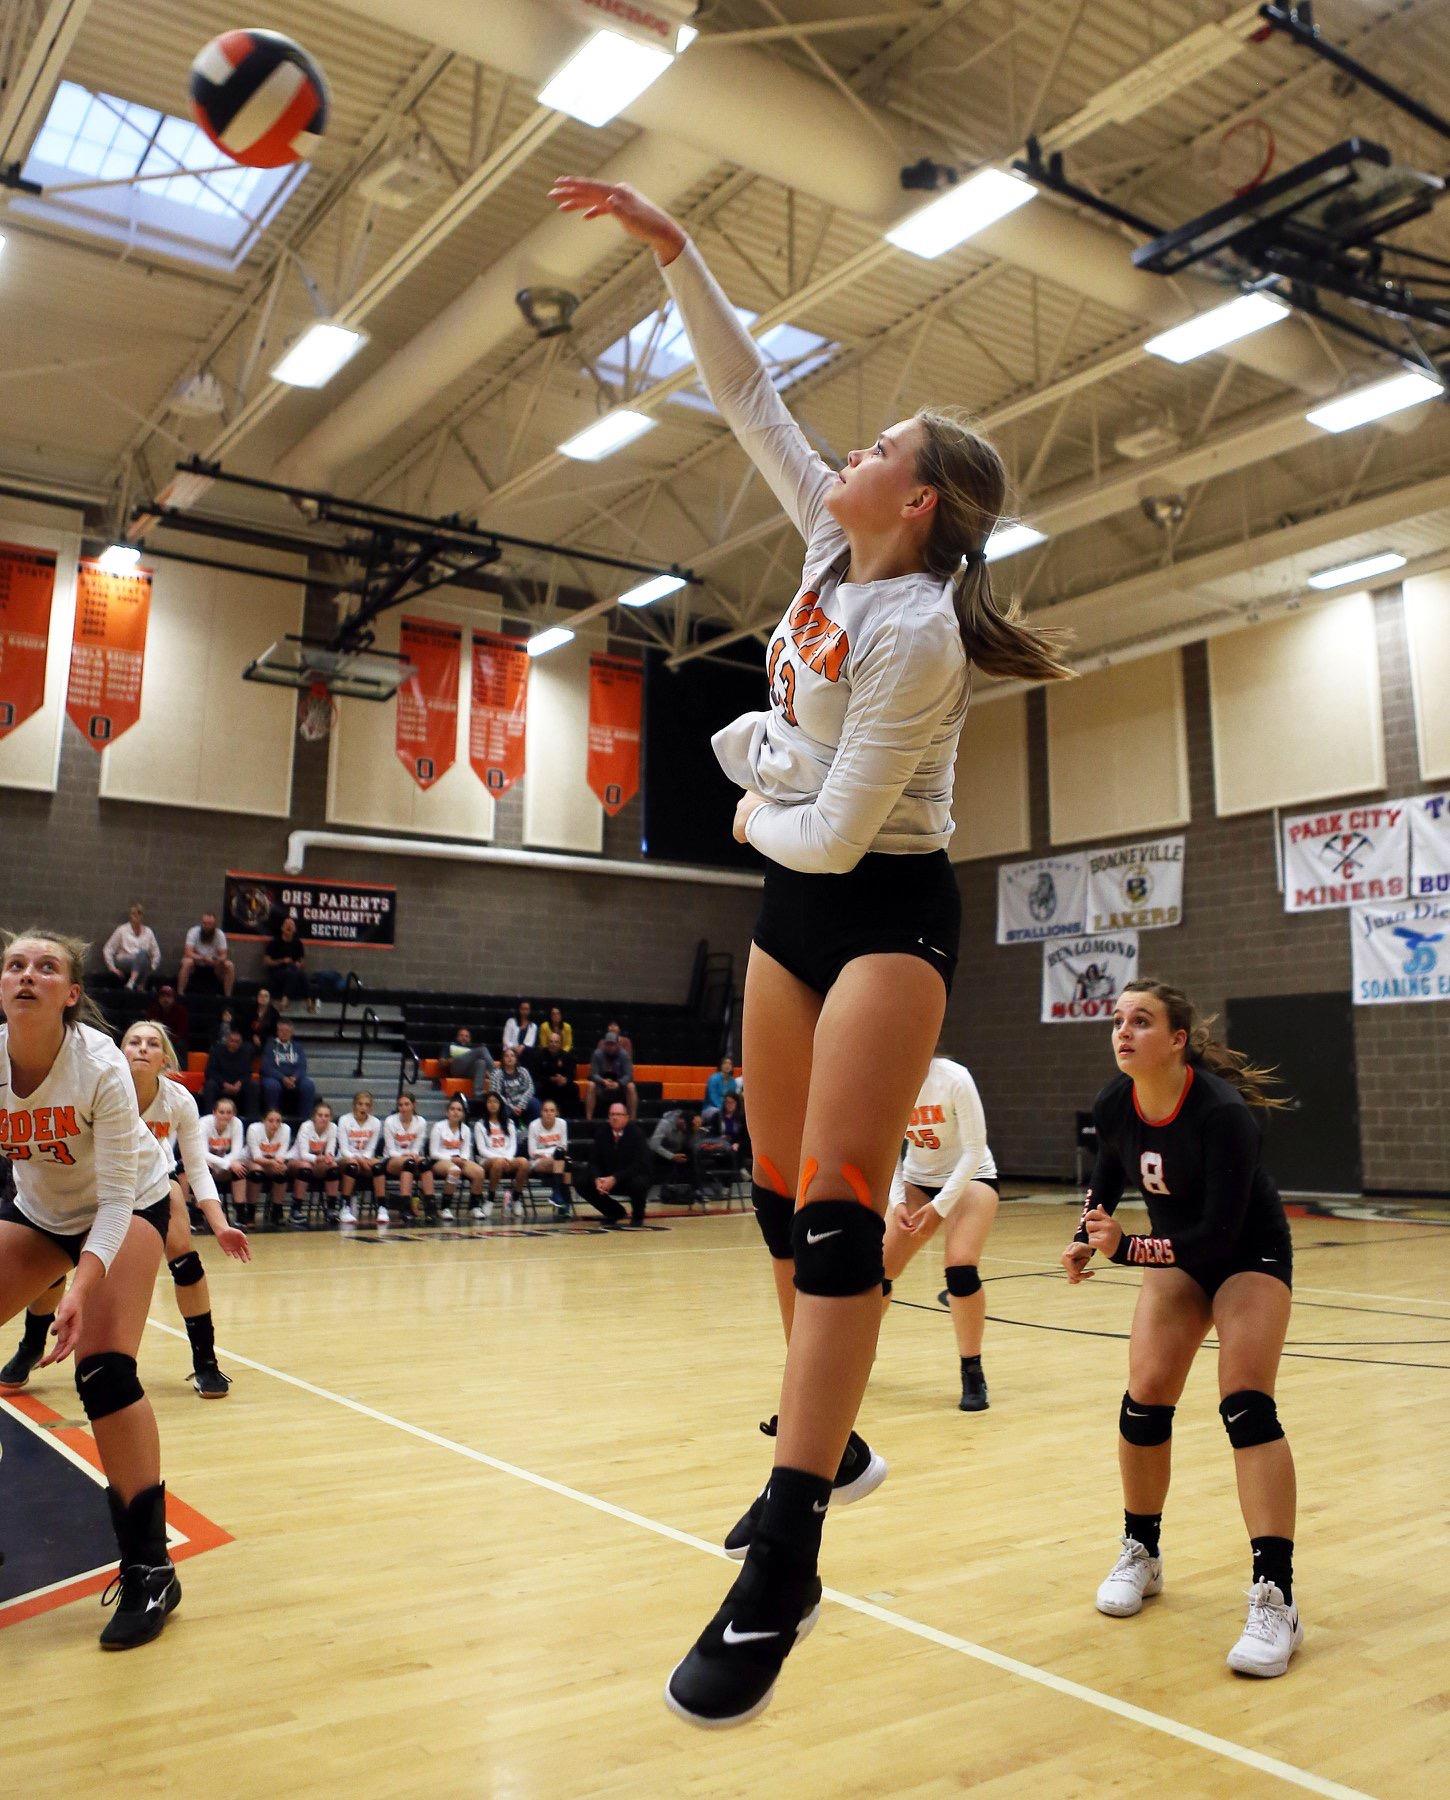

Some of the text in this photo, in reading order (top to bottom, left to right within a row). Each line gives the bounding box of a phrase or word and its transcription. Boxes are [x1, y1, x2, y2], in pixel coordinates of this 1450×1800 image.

[90, 715, 111, 740] O
[416, 758, 434, 780] O
[487, 768, 504, 789] O
[604, 784, 621, 805] O
[1424, 796, 1450, 819] T
[1288, 808, 1402, 844] PARK CITY
[281, 889, 390, 912] OHS PARENTS
[1294, 877, 1404, 907] MINERS
[303, 907, 382, 925] COMMUNITY
[1094, 907, 1179, 929] LAKERS
[1364, 911, 1407, 938] Juan
[310, 923, 357, 938] SECTION
[1006, 923, 1081, 940] STALLIONS
[1361, 976, 1431, 999] SOARING
[1140, 1151, 1171, 1195] 8
